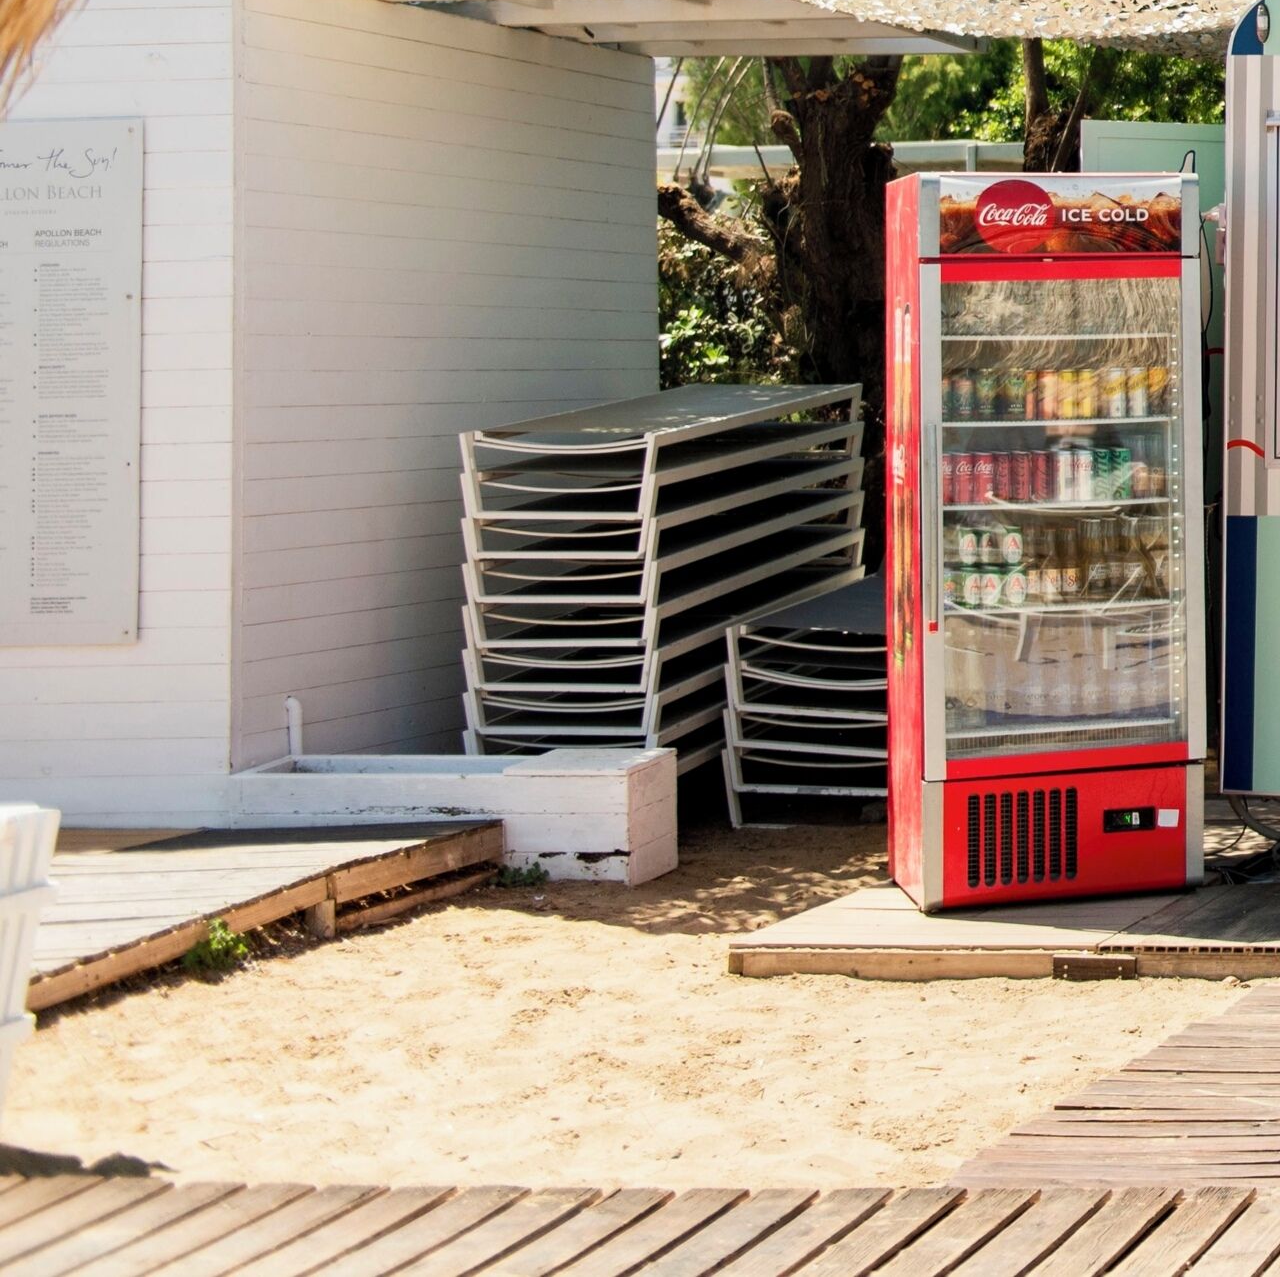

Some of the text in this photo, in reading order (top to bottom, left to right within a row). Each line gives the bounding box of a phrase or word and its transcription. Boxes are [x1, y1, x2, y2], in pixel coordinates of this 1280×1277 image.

[0, 184, 102, 201] LON BEACH
[979, 203, 1149, 226] Coca-Cola ICE COLD
[34, 228, 102, 238] APOLLON BEACH
